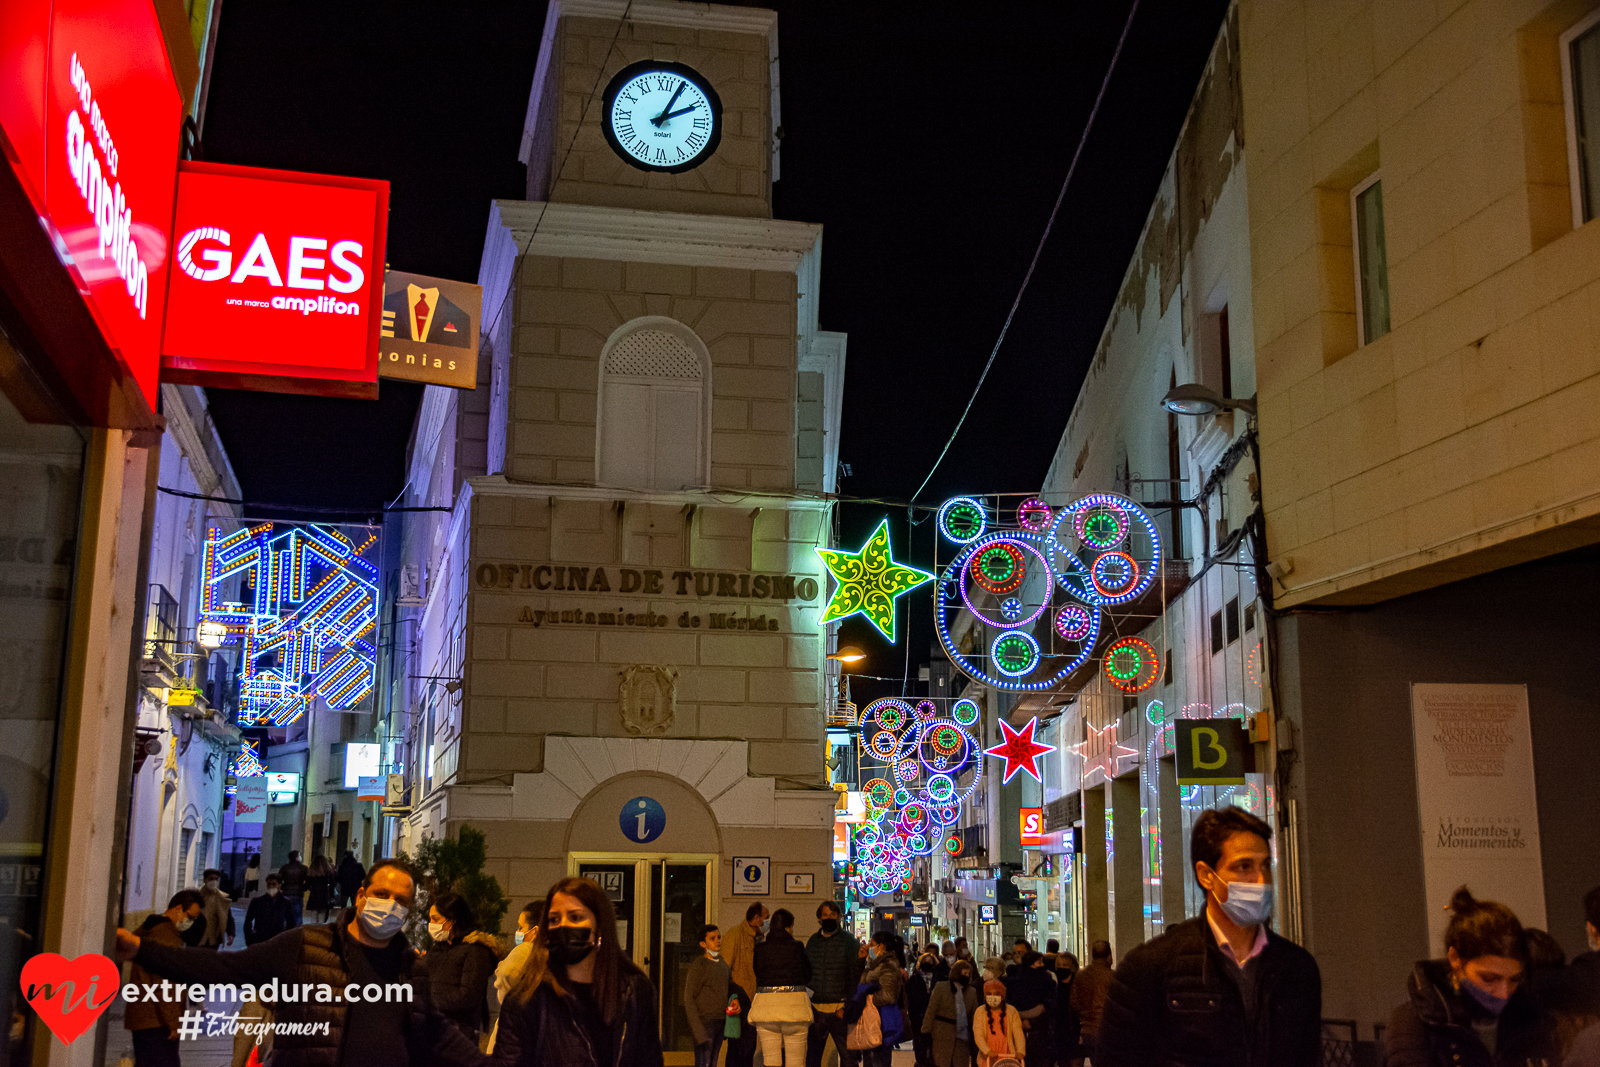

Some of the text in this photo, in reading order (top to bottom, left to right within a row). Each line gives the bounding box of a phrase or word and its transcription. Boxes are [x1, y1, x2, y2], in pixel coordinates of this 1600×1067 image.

[637, 81, 652, 95] XI
[657, 78, 674, 93] XII
[625, 92, 638, 105] X
[69, 51, 119, 177] una marca
[693, 117, 706, 130] III
[676, 146, 686, 158] V
[66, 109, 148, 321] amplifon
[177, 226, 365, 294] GAES
[226, 295, 360, 316] una marca amplifon
[475, 563, 819, 602] OFICINA DE TURISMO
[518, 605, 780, 631] Ayuntamiento de Mérida
[1191, 727, 1227, 770] B
[1438, 823, 1522, 840] Momentos y
[1436, 834, 1526, 849] Monumentos
